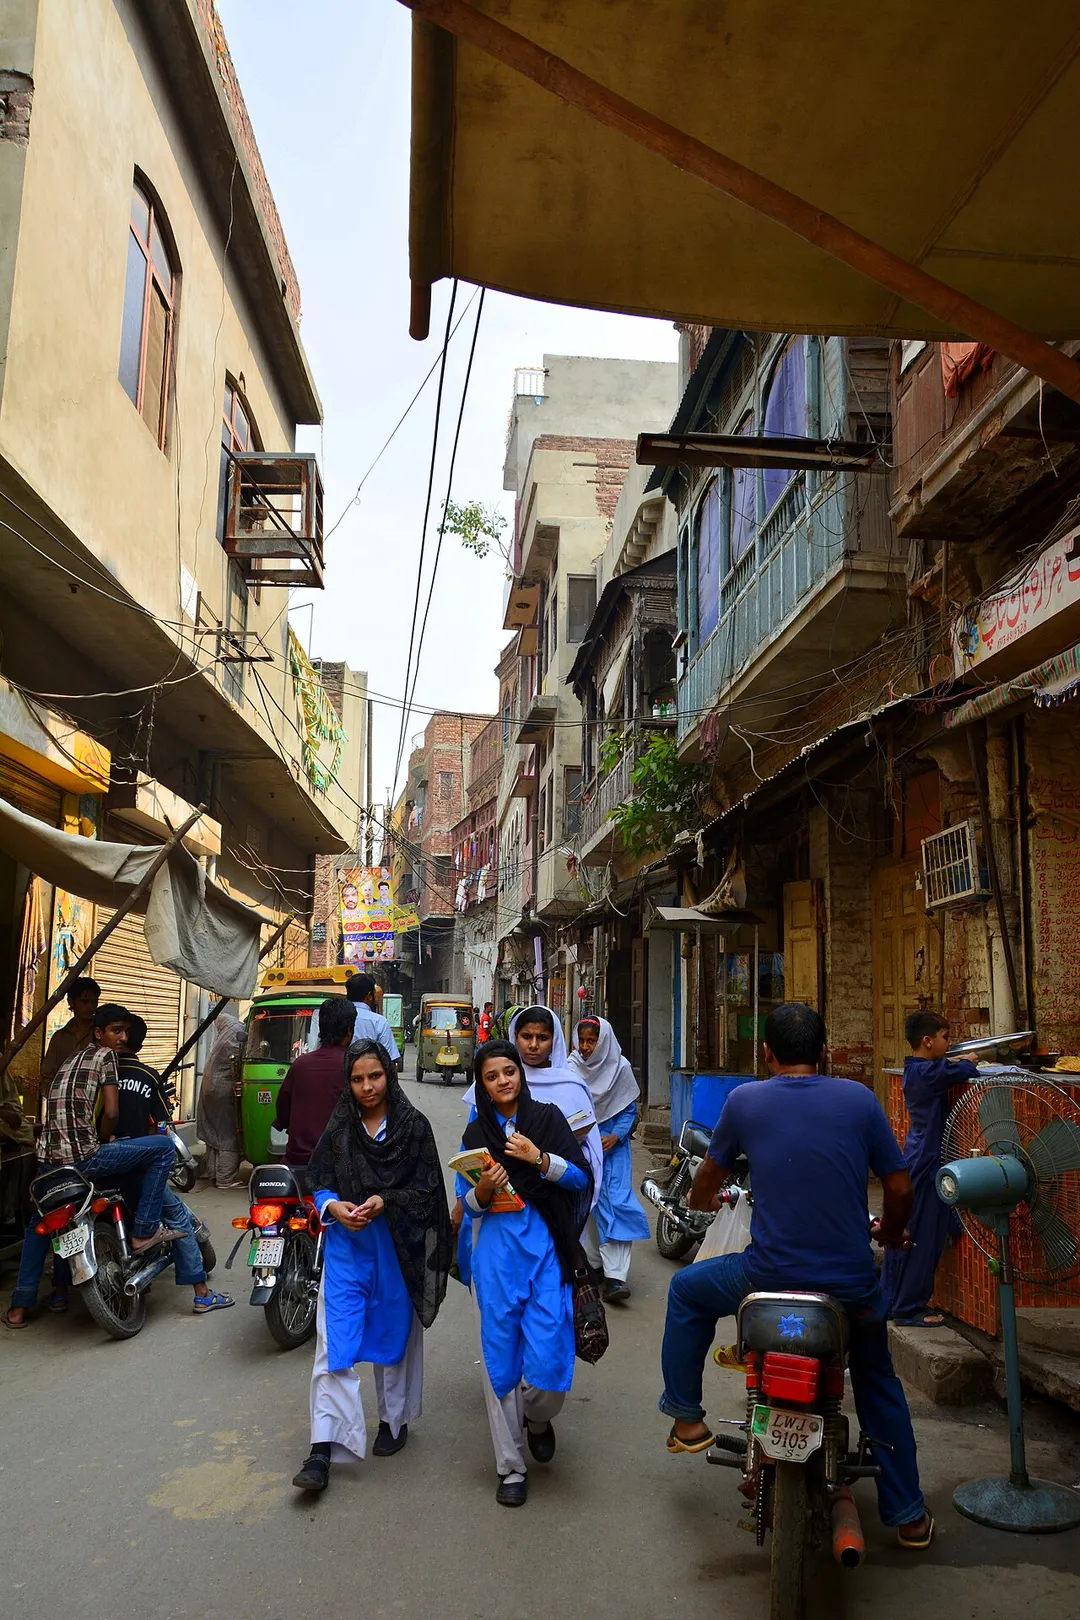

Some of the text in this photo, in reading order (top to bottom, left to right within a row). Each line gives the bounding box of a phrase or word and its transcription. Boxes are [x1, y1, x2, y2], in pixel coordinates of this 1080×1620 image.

[1035, 848, 1047, 858] 20
[1035, 862, 1047, 871] 20
[1039, 872, 1046, 882] 8
[1039, 882, 1047, 890] 6
[1042, 890, 1048, 898] 8
[1037, 899, 1048, 907] 15
[1041, 908, 1048, 916] 8
[1039, 926, 1050, 935] 20
[1039, 935, 1050, 944] 20
[1039, 944, 1051, 953] 25
[140, 1084, 152, 1099] FC
[772, 1413, 806, 1432] LWJ
[771, 1429, 809, 1450] 9103
